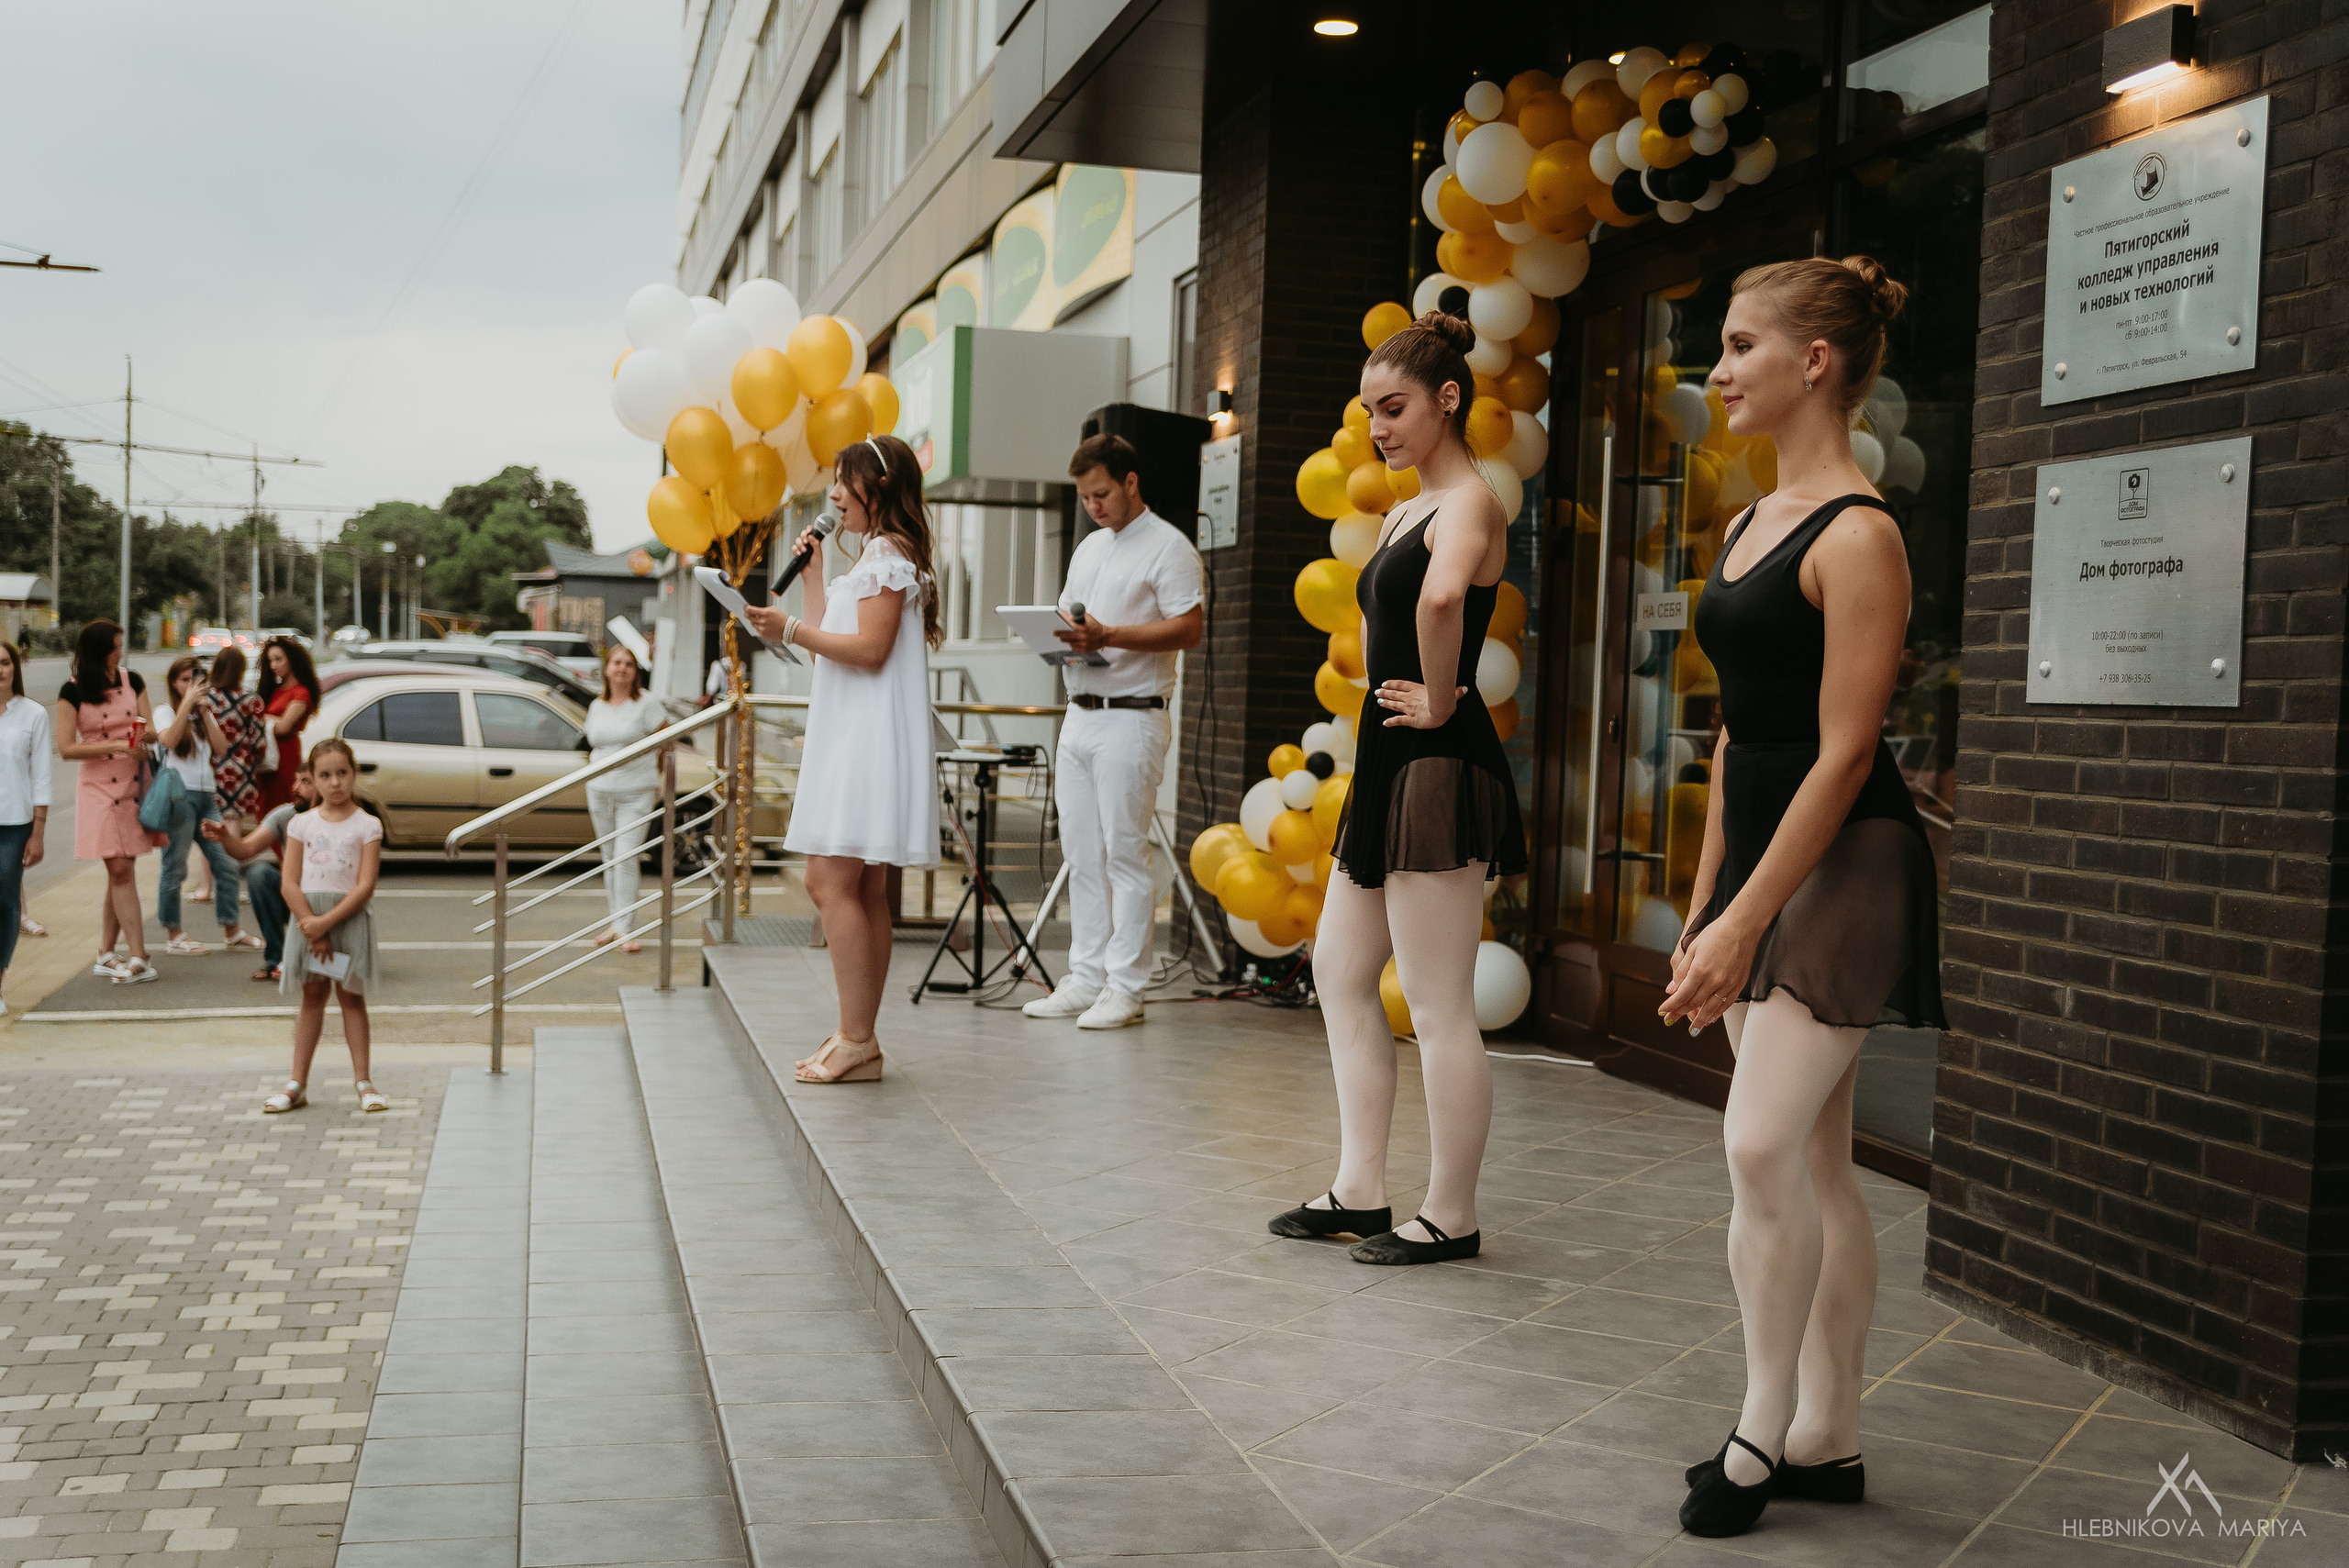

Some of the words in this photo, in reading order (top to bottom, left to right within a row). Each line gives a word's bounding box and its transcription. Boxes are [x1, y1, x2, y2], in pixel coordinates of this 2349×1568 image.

[2074, 227, 2094, 239] Частное
[2095, 213, 2144, 234] профессиональное
[2145, 197, 2193, 218] образовательное
[2194, 187, 2231, 206] учреждение
[2104, 218, 2190, 258] Пятигорский
[2077, 263, 2133, 290] колледж
[2137, 241, 2219, 280] управления
[2079, 300, 2087, 314] и
[2090, 290, 2131, 312] новых
[2134, 264, 2214, 301] технологий
[2115, 319, 2132, 329] пн-пт
[2134, 309, 2168, 326] 9:00-17:00
[2124, 330, 2132, 340] сб
[2134, 323, 2167, 339] 9:00-14:00
[2101, 362, 2130, 373] Пятигорск,
[2131, 361, 2140, 370] ул.
[2141, 352, 2178, 367] Февральская,
[2179, 350, 2188, 360] 54
[2100, 539, 2131, 549] Творческая
[2131, 536, 2164, 547] фотостудия
[2079, 562, 2105, 582] Дом
[2109, 555, 2183, 581] фотографа
[1643, 605, 1653, 617] НА
[1657, 602, 1681, 618] СЕБЯ
[2092, 630, 2126, 640] 10:00-22:00
[2128, 630, 2138, 641] (по
[2139, 629, 2164, 640] записи)
[2105, 644, 2116, 653] без
[2117, 645, 2147, 654] выходных
[2099, 674, 2107, 683] +7
[2108, 673, 2120, 684] 938
[2121, 673, 2152, 684] 306-35-25
